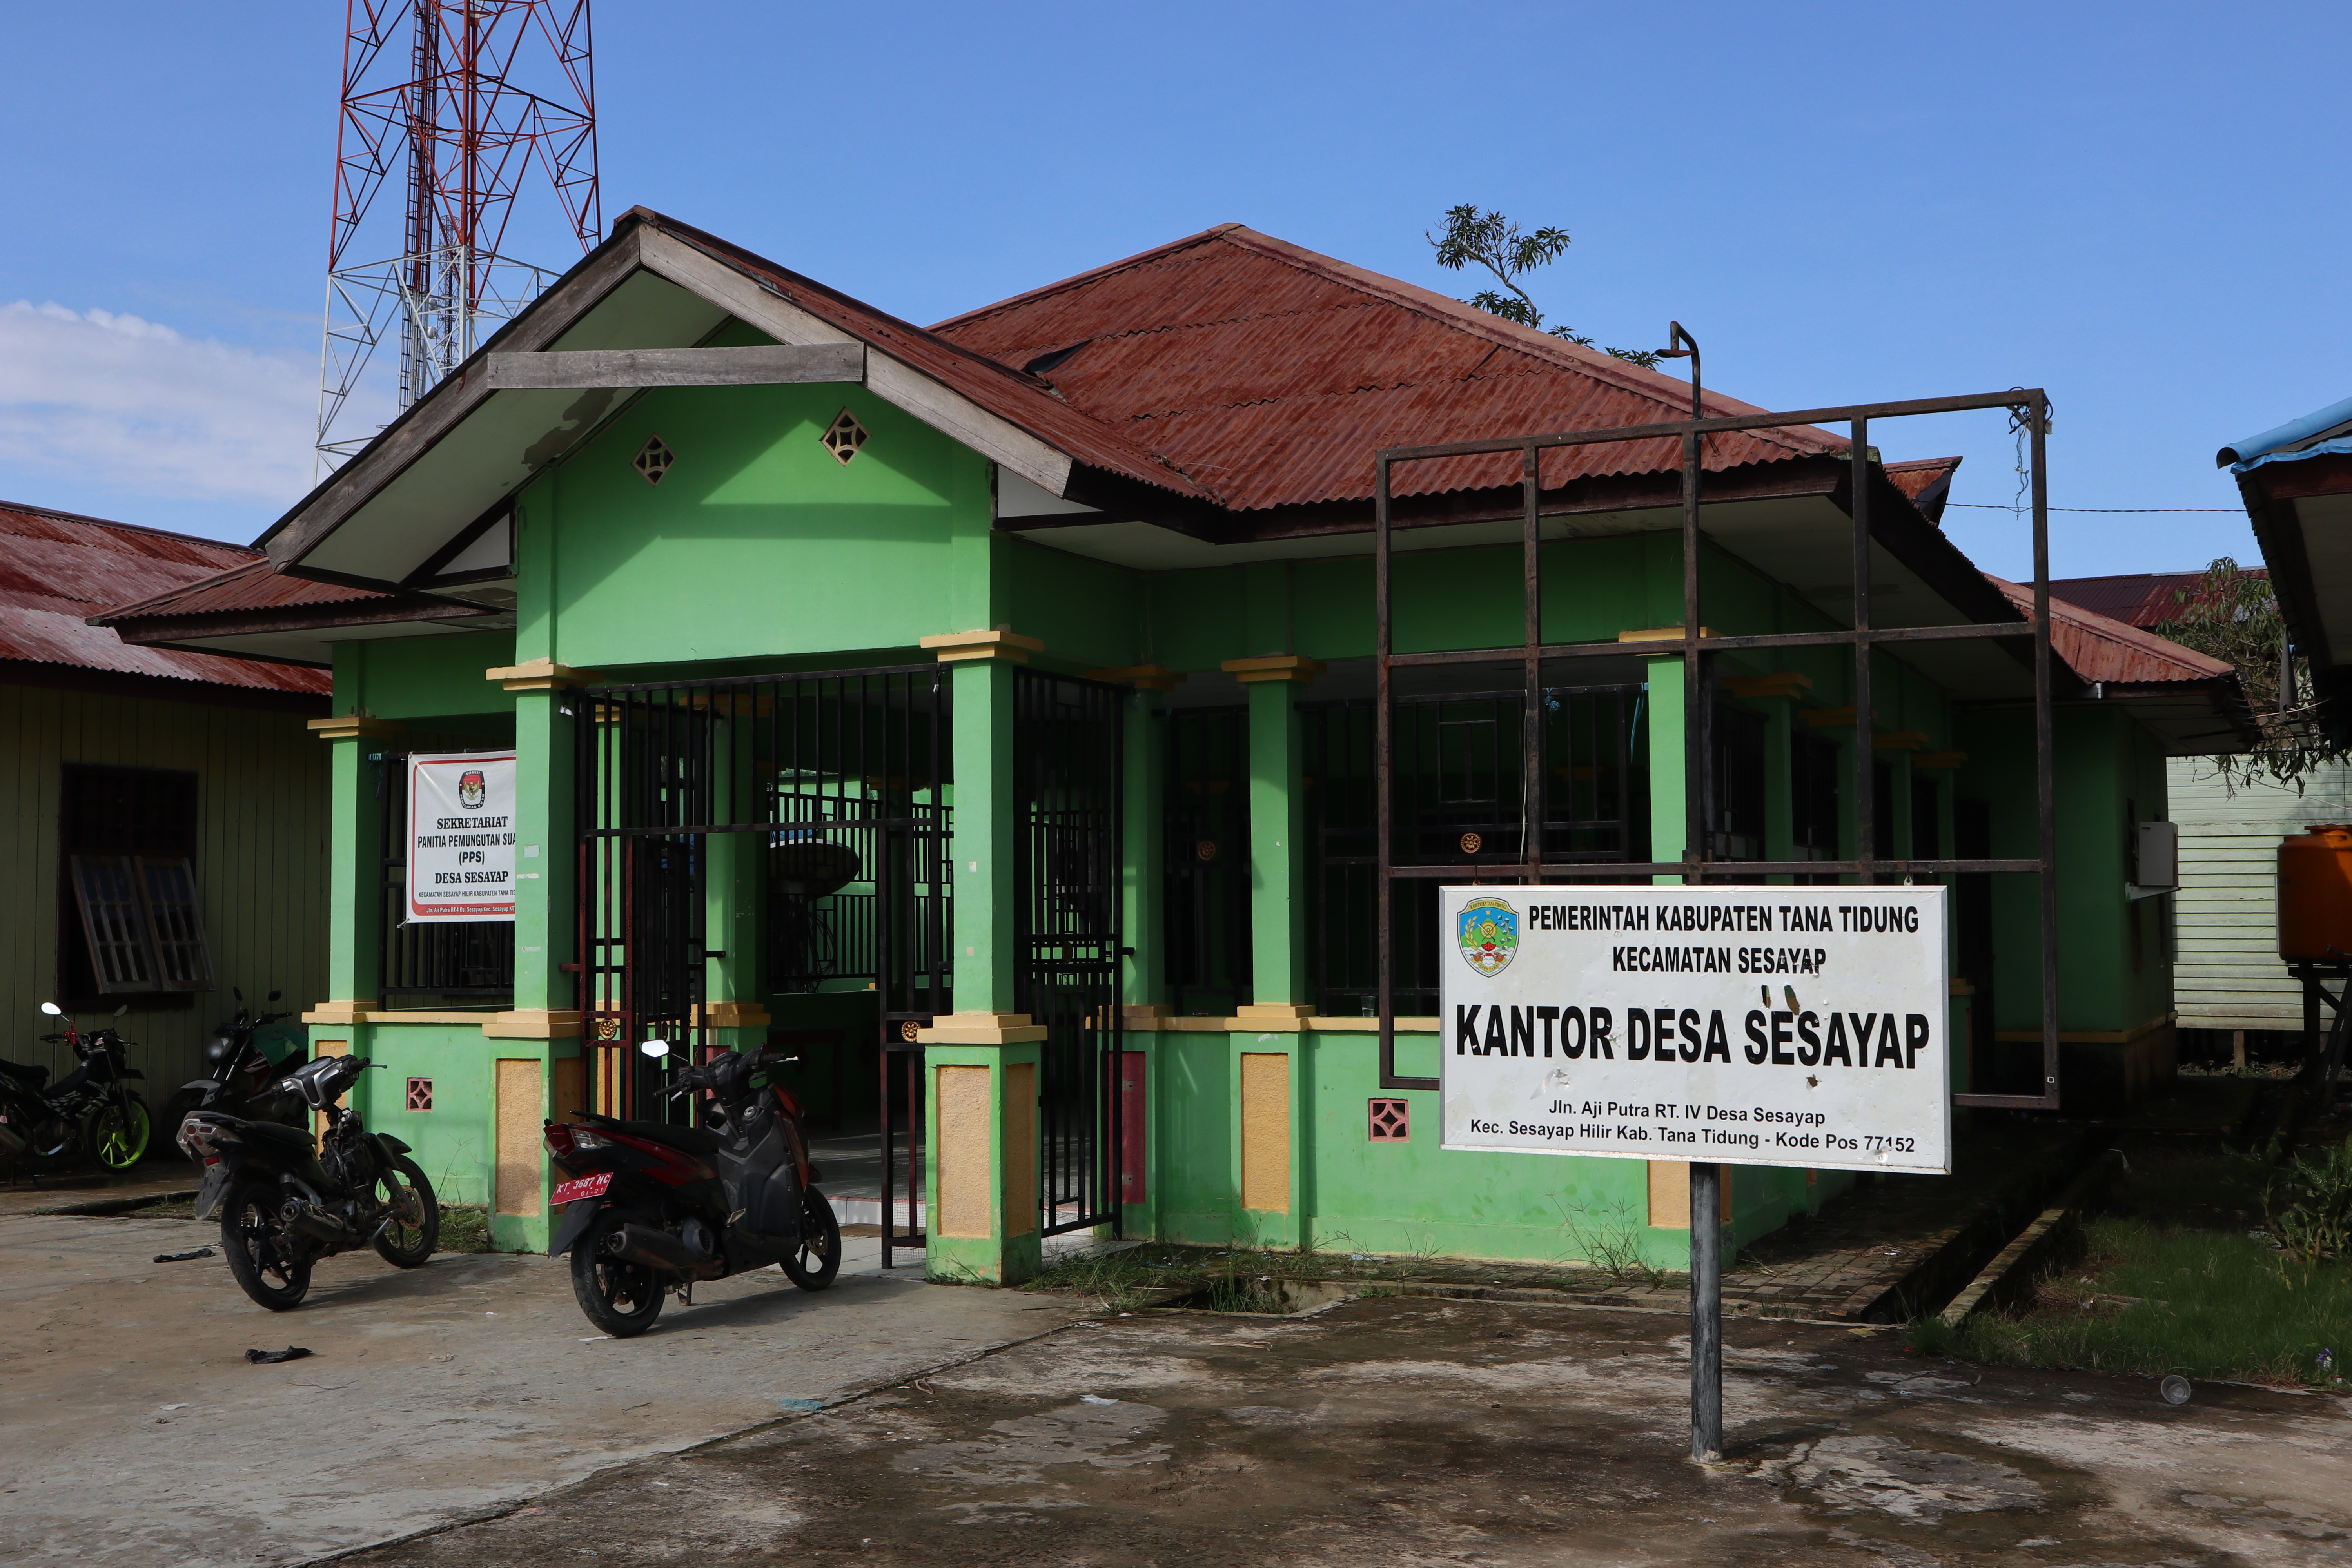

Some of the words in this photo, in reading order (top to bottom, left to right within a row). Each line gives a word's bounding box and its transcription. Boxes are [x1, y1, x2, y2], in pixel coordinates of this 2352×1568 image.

[460, 794, 477, 809] PEMILIHAN
[437, 816, 508, 829] SEKRETARIAT
[418, 835, 446, 848] PANITIA
[449, 833, 500, 847] PEMUNGUTAN
[459, 851, 485, 866] (PPS)
[435, 872, 462, 884] DESA
[464, 871, 509, 883] SESAYAP
[1530, 906, 1648, 930] PEMERINTAH
[1657, 906, 1771, 931] KABUPATEN
[1779, 906, 1833, 931] TANA
[1839, 906, 1918, 933] TIDUNG
[1613, 947, 1730, 972] KECAMATAN
[1739, 947, 1826, 974] SESAYAP
[1457, 1005, 1614, 1059] KANTOR
[1628, 1008, 1731, 1063] DESA
[1744, 1009, 1929, 1069] SESAYAP
[1550, 1100, 1576, 1114] Jln.
[1582, 1101, 1601, 1118] Aji
[1608, 1102, 1649, 1117] Putra
[1656, 1104, 1679, 1118] RT.
[1686, 1105, 1700, 1119] IV
[1708, 1106, 1747, 1121] Desa
[1754, 1108, 1824, 1127] Sesayap
[1472, 1120, 1503, 1133] Kec.
[1509, 1121, 1573, 1140] Sesayap
[1581, 1124, 1612, 1138] Hilir
[1618, 1125, 1651, 1140] Kab.
[1658, 1127, 1695, 1142] Tana
[1702, 1129, 1758, 1149] Tidung
[1777, 1132, 1819, 1148] Kode
[1827, 1134, 1857, 1149] Pos
[1865, 1136, 1914, 1152] 77152
[557, 1182, 570, 1194] KT
[573, 1177, 595, 1189] 3687
